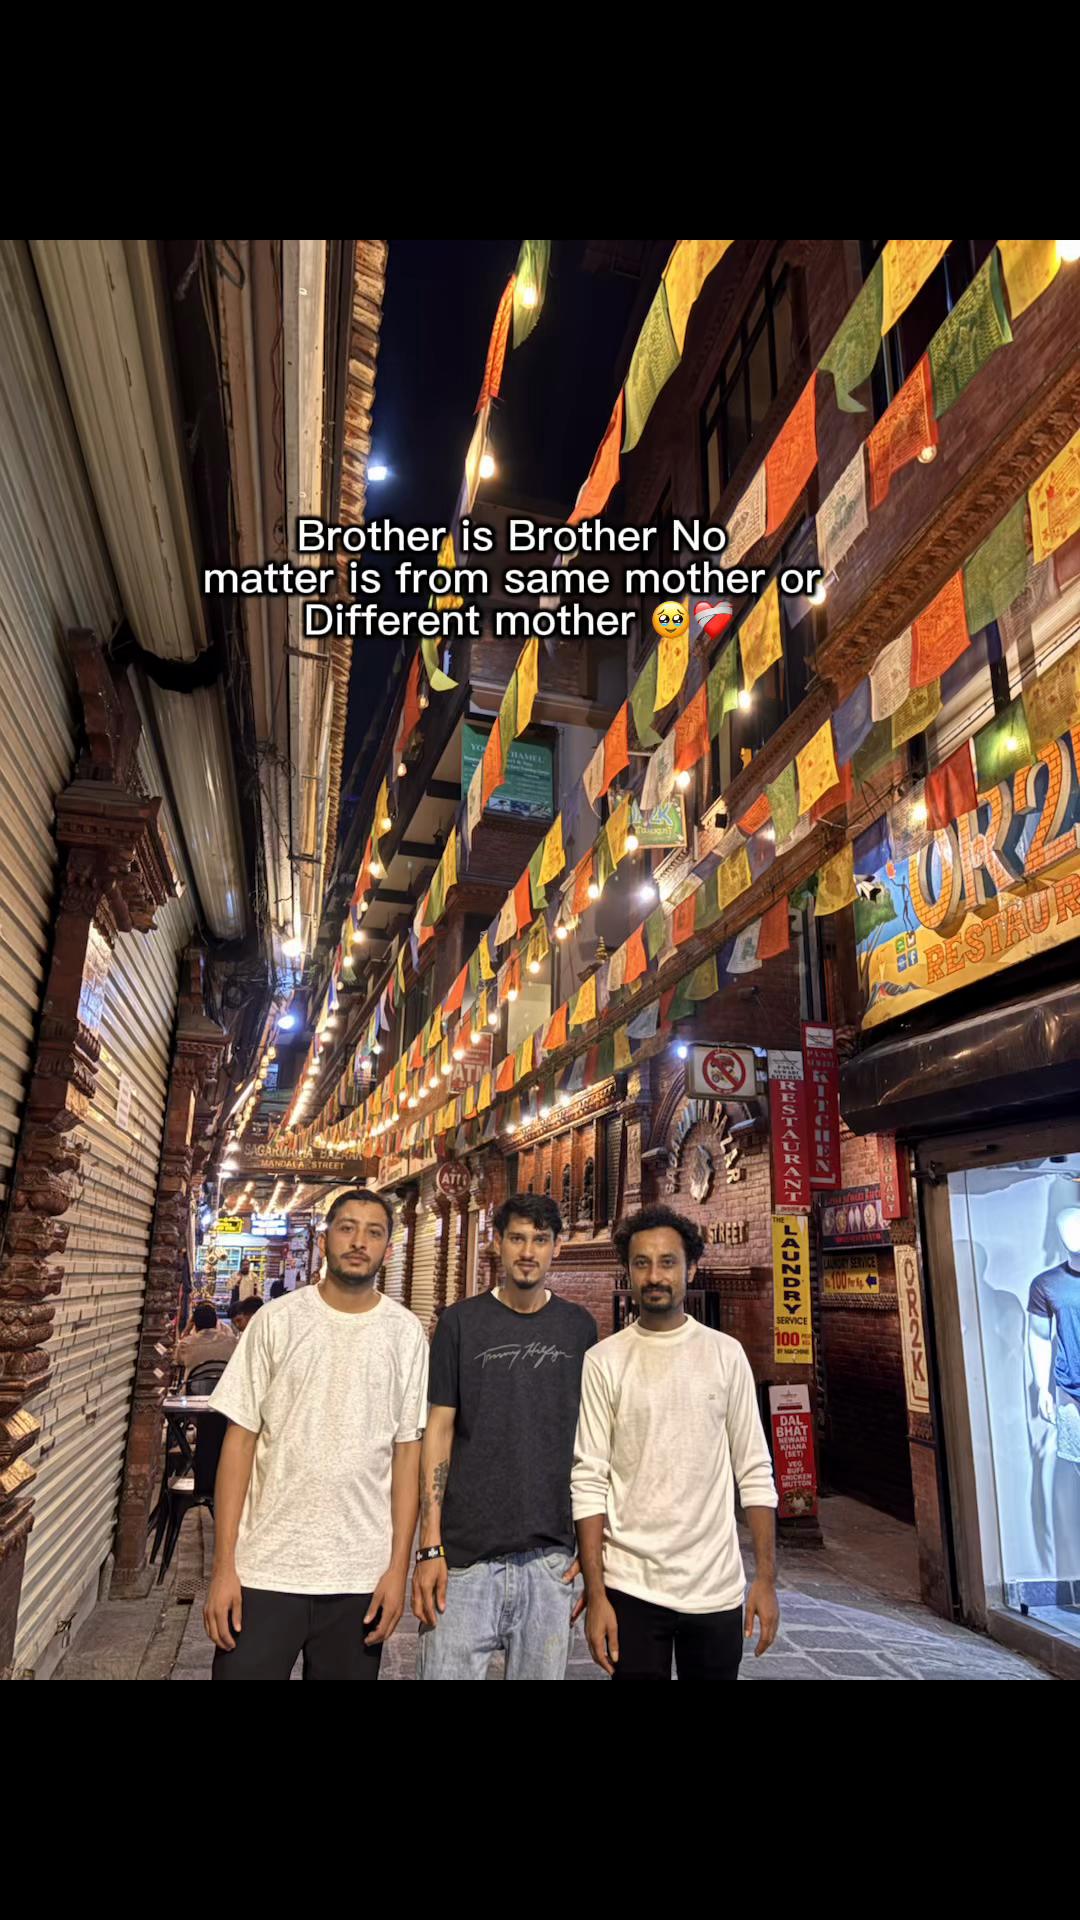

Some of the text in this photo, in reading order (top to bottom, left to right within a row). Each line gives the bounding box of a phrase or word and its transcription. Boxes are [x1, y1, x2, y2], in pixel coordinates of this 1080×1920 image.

[813, 1070, 831, 1173] KITCHEN
[779, 1080, 802, 1202] RESTAURANT
[260, 1159, 345, 1169] MANDALA STREET
[772, 1216, 785, 1224] THE
[707, 1220, 745, 1245] STREET
[781, 1225, 801, 1315] LAUNDRY
[776, 1316, 808, 1326] SERVICE
[903, 1258, 926, 1383] OR2K
[776, 1331, 800, 1347] 100
[779, 1415, 804, 1427] DAL
[776, 1425, 809, 1438] BHAT
[781, 1473, 813, 1482] CHICKEN
[782, 1480, 813, 1489] MUTTON
